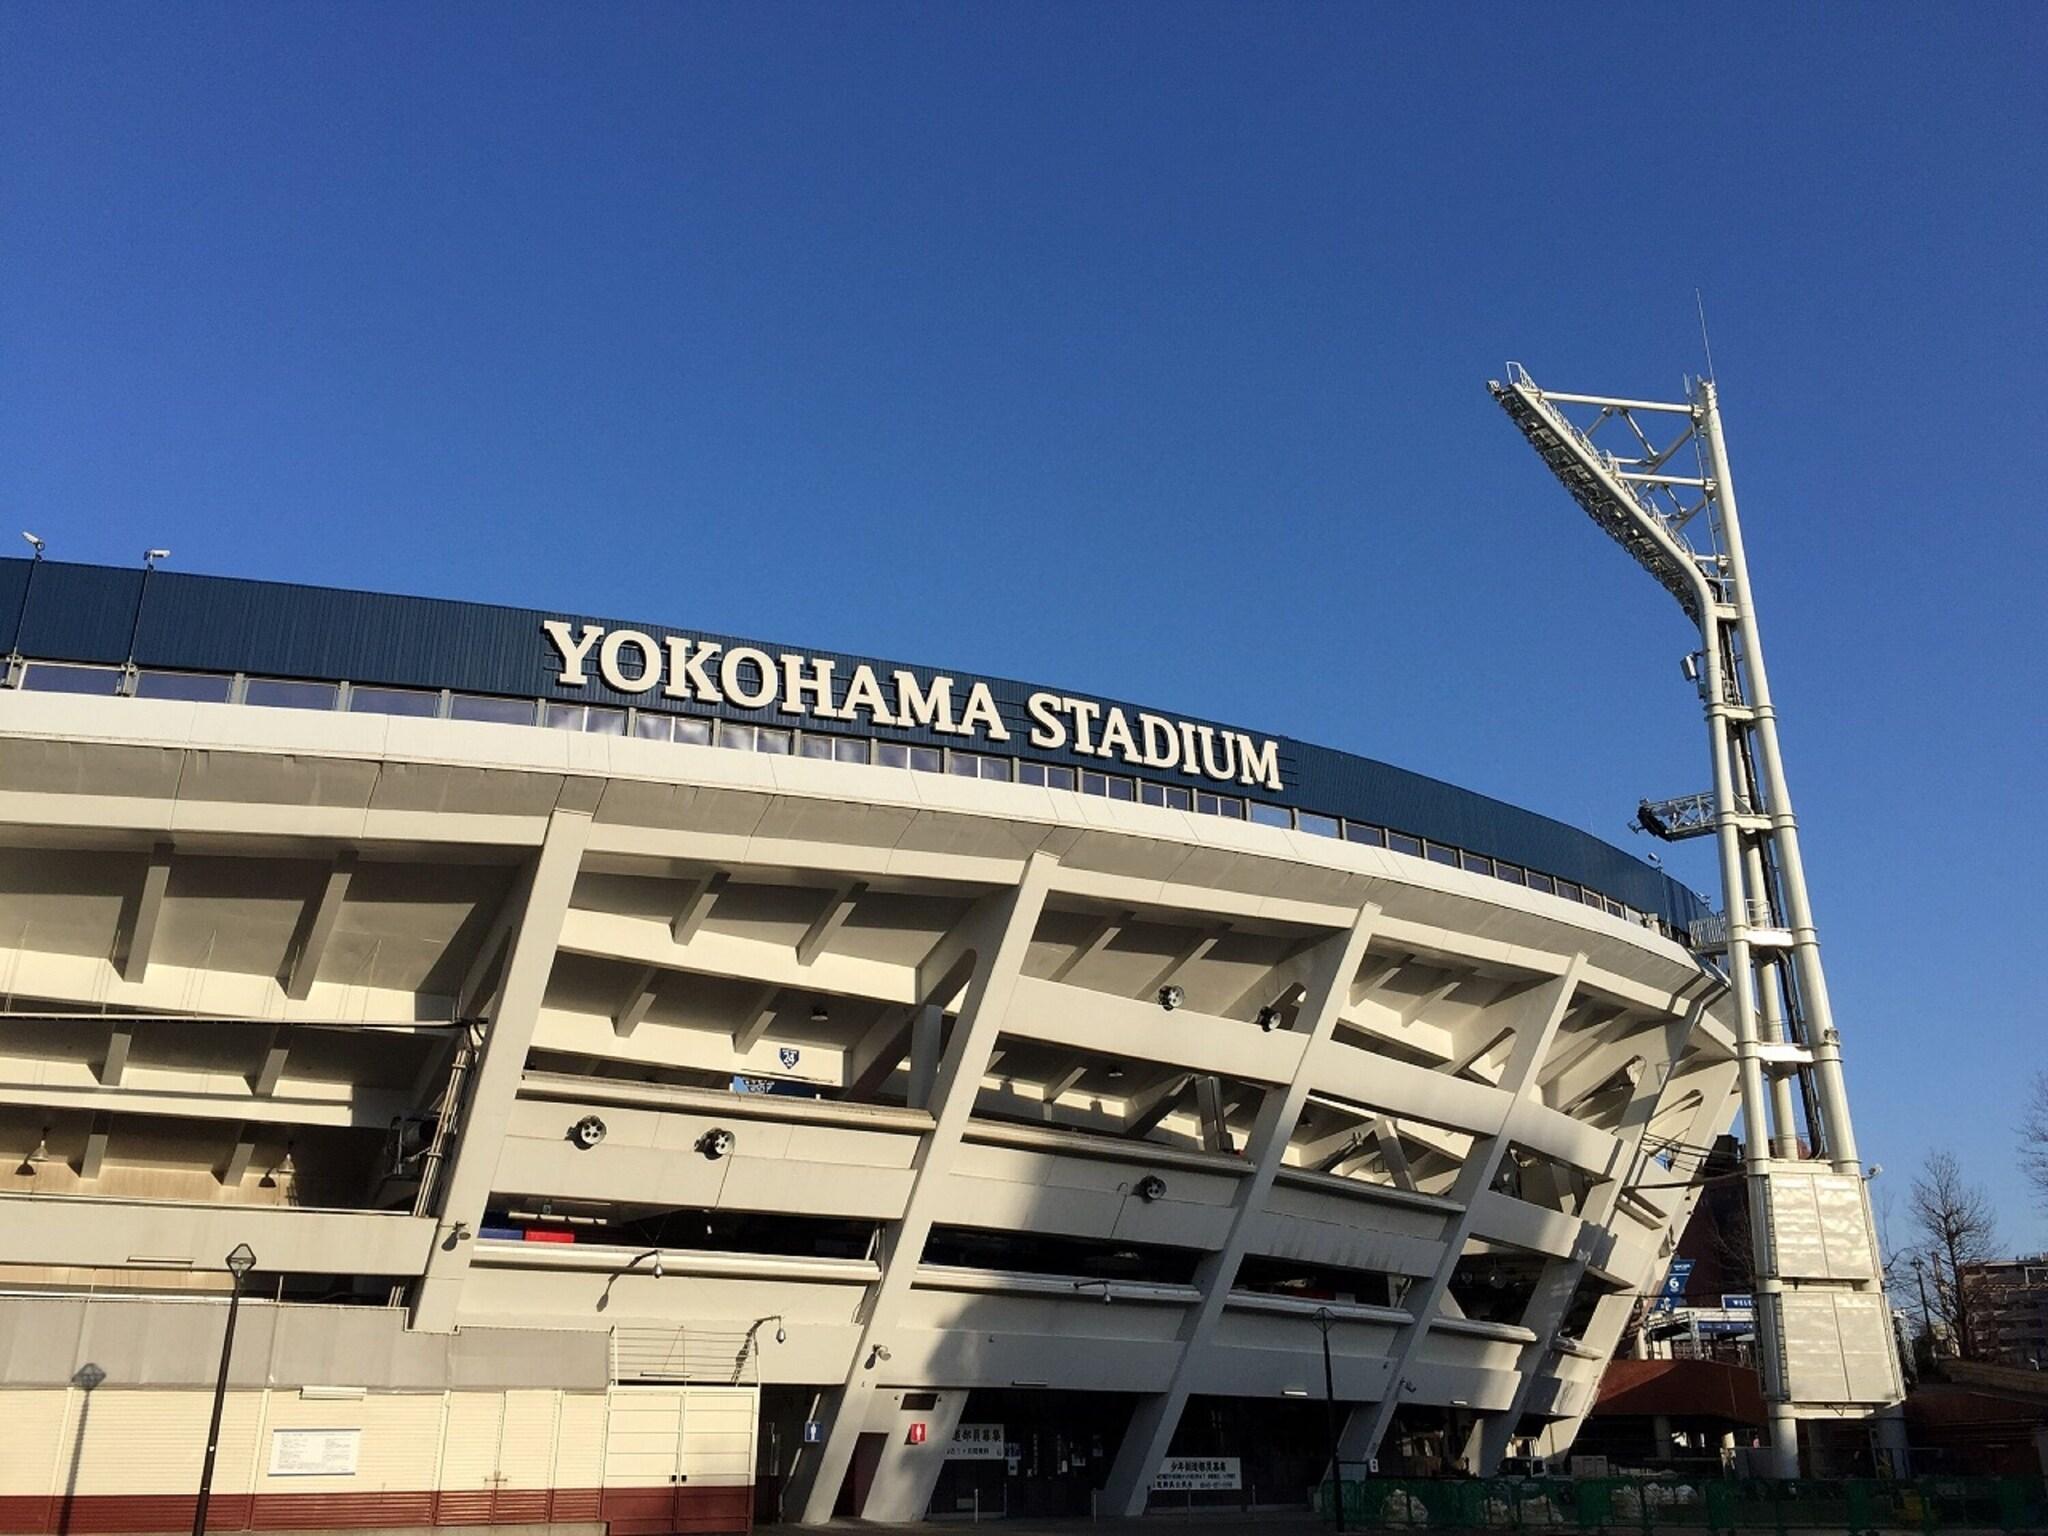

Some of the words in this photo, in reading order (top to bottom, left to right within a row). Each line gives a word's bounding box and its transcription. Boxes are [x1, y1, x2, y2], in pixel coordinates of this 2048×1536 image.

[543, 620, 1010, 740] YOKOHAMA
[1027, 691, 1284, 791] STADIUM
[1670, 1277, 1679, 1288] 6
